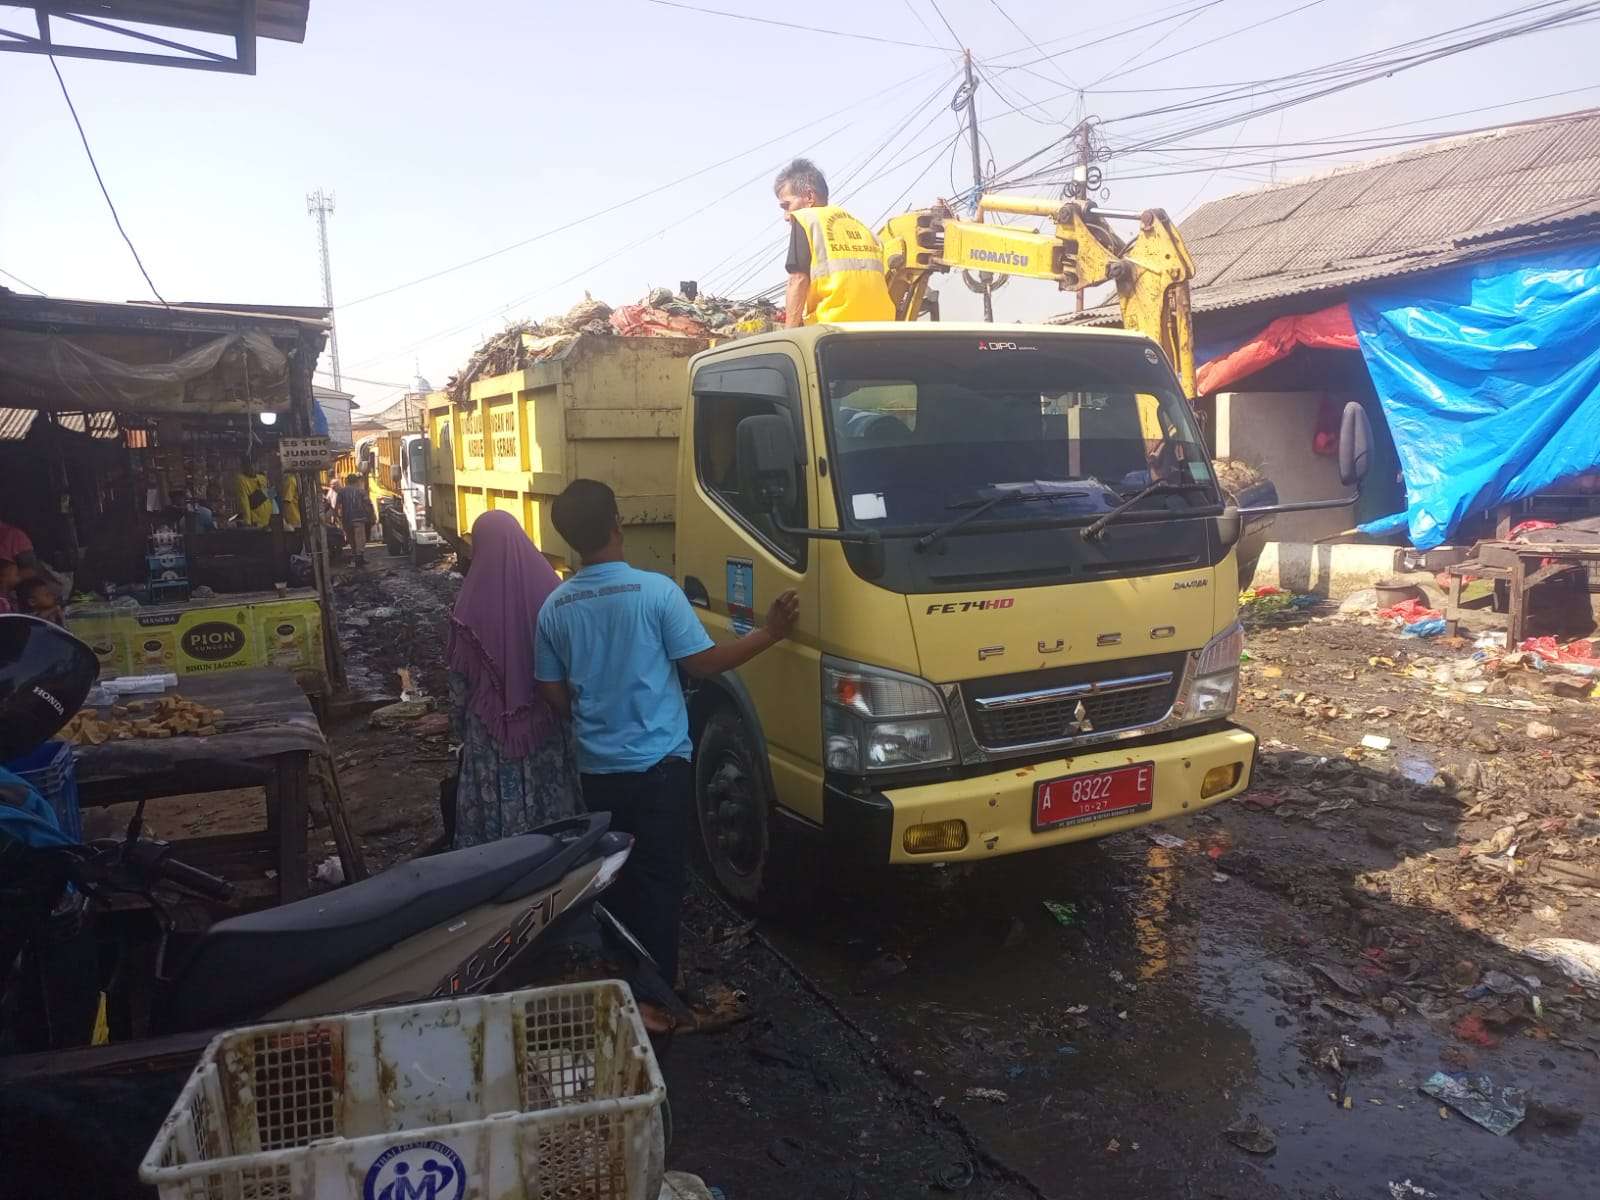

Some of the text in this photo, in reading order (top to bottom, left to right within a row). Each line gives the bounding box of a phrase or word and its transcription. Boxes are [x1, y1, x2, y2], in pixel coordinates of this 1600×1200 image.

[970, 248, 1029, 267] KOMATSU
[988, 342, 1017, 351] DIPO
[283, 449, 328, 458] JUMBO
[926, 597, 1015, 616] FE74HD
[191, 631, 236, 646] PION
[978, 625, 1176, 662] FUSO
[32, 686, 65, 716] HONDA
[1042, 768, 1148, 810] A 8322 E
[1080, 800, 1108, 813] 10-27
